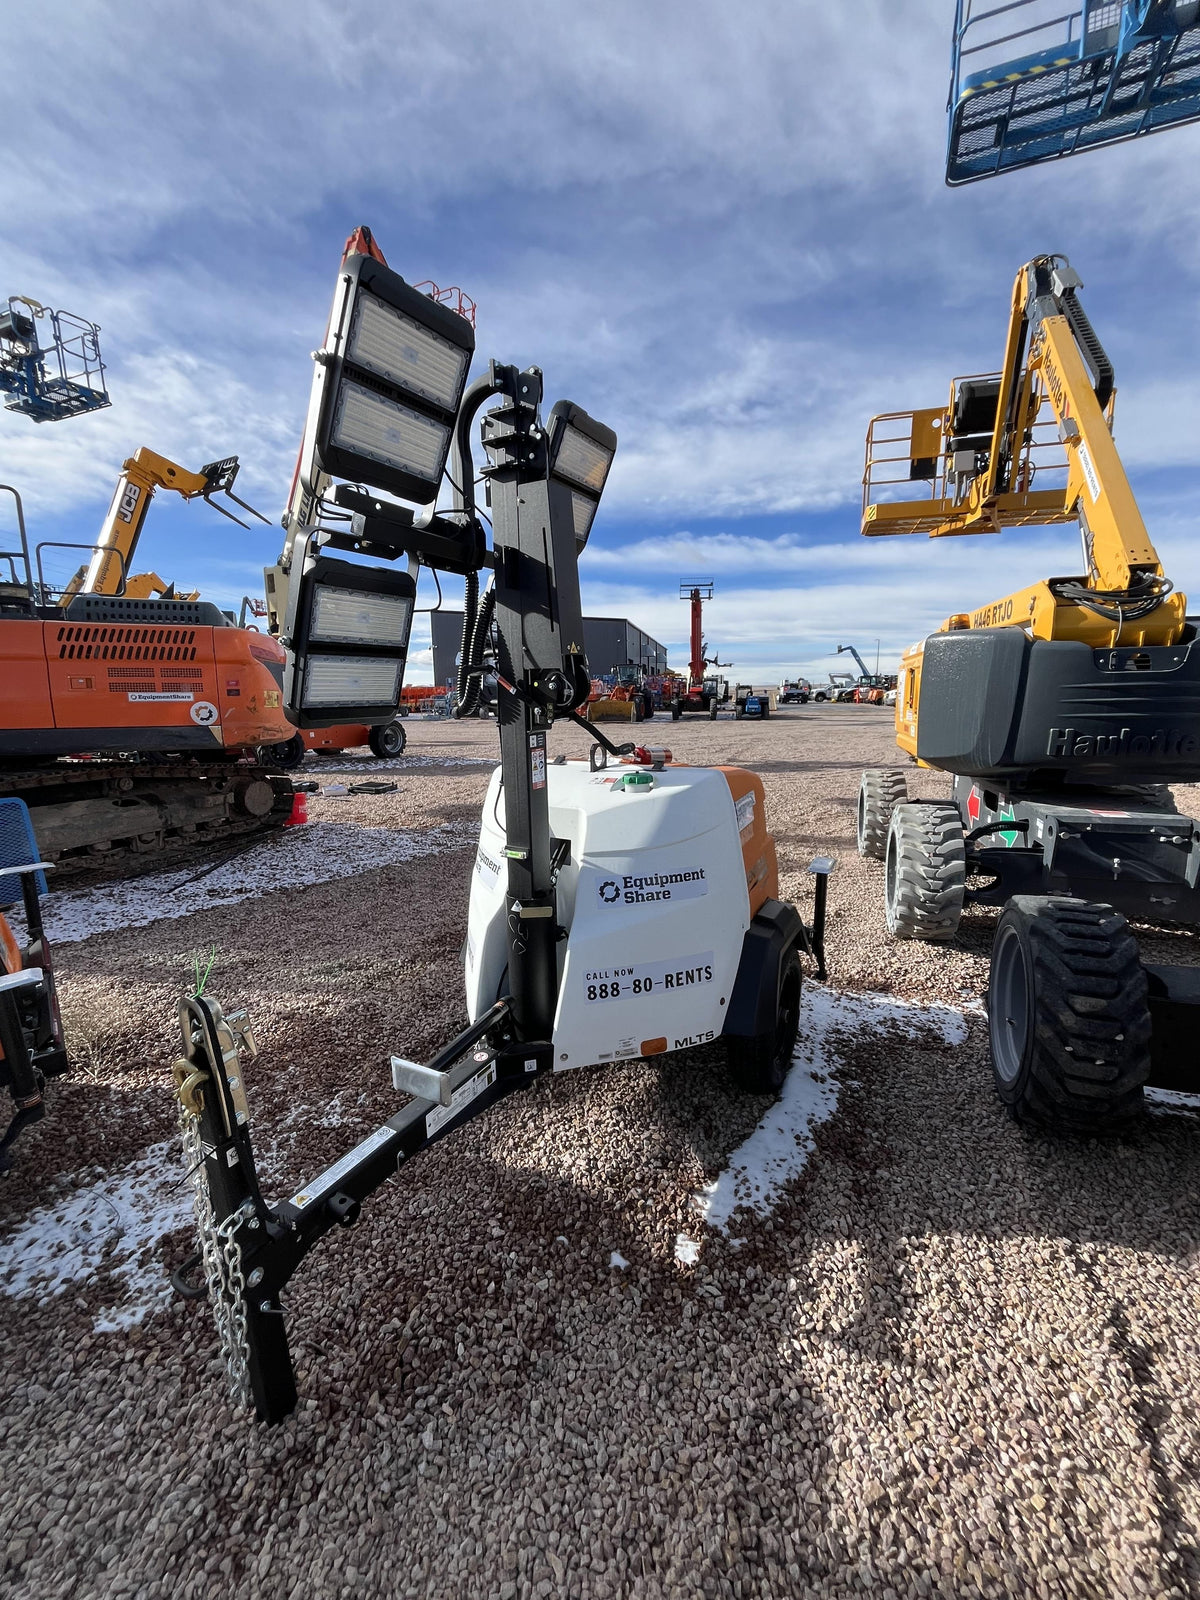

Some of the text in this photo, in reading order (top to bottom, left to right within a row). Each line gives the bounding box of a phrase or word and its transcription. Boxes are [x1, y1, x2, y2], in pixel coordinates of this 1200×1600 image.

[118, 483, 141, 523] JCB
[622, 868, 705, 890] Equipment
[624, 890, 671, 904] Share
[586, 968, 634, 981] CALL NOW
[587, 965, 713, 1001] 888-80-RENTS
[674, 1030, 715, 1049] MLTS
